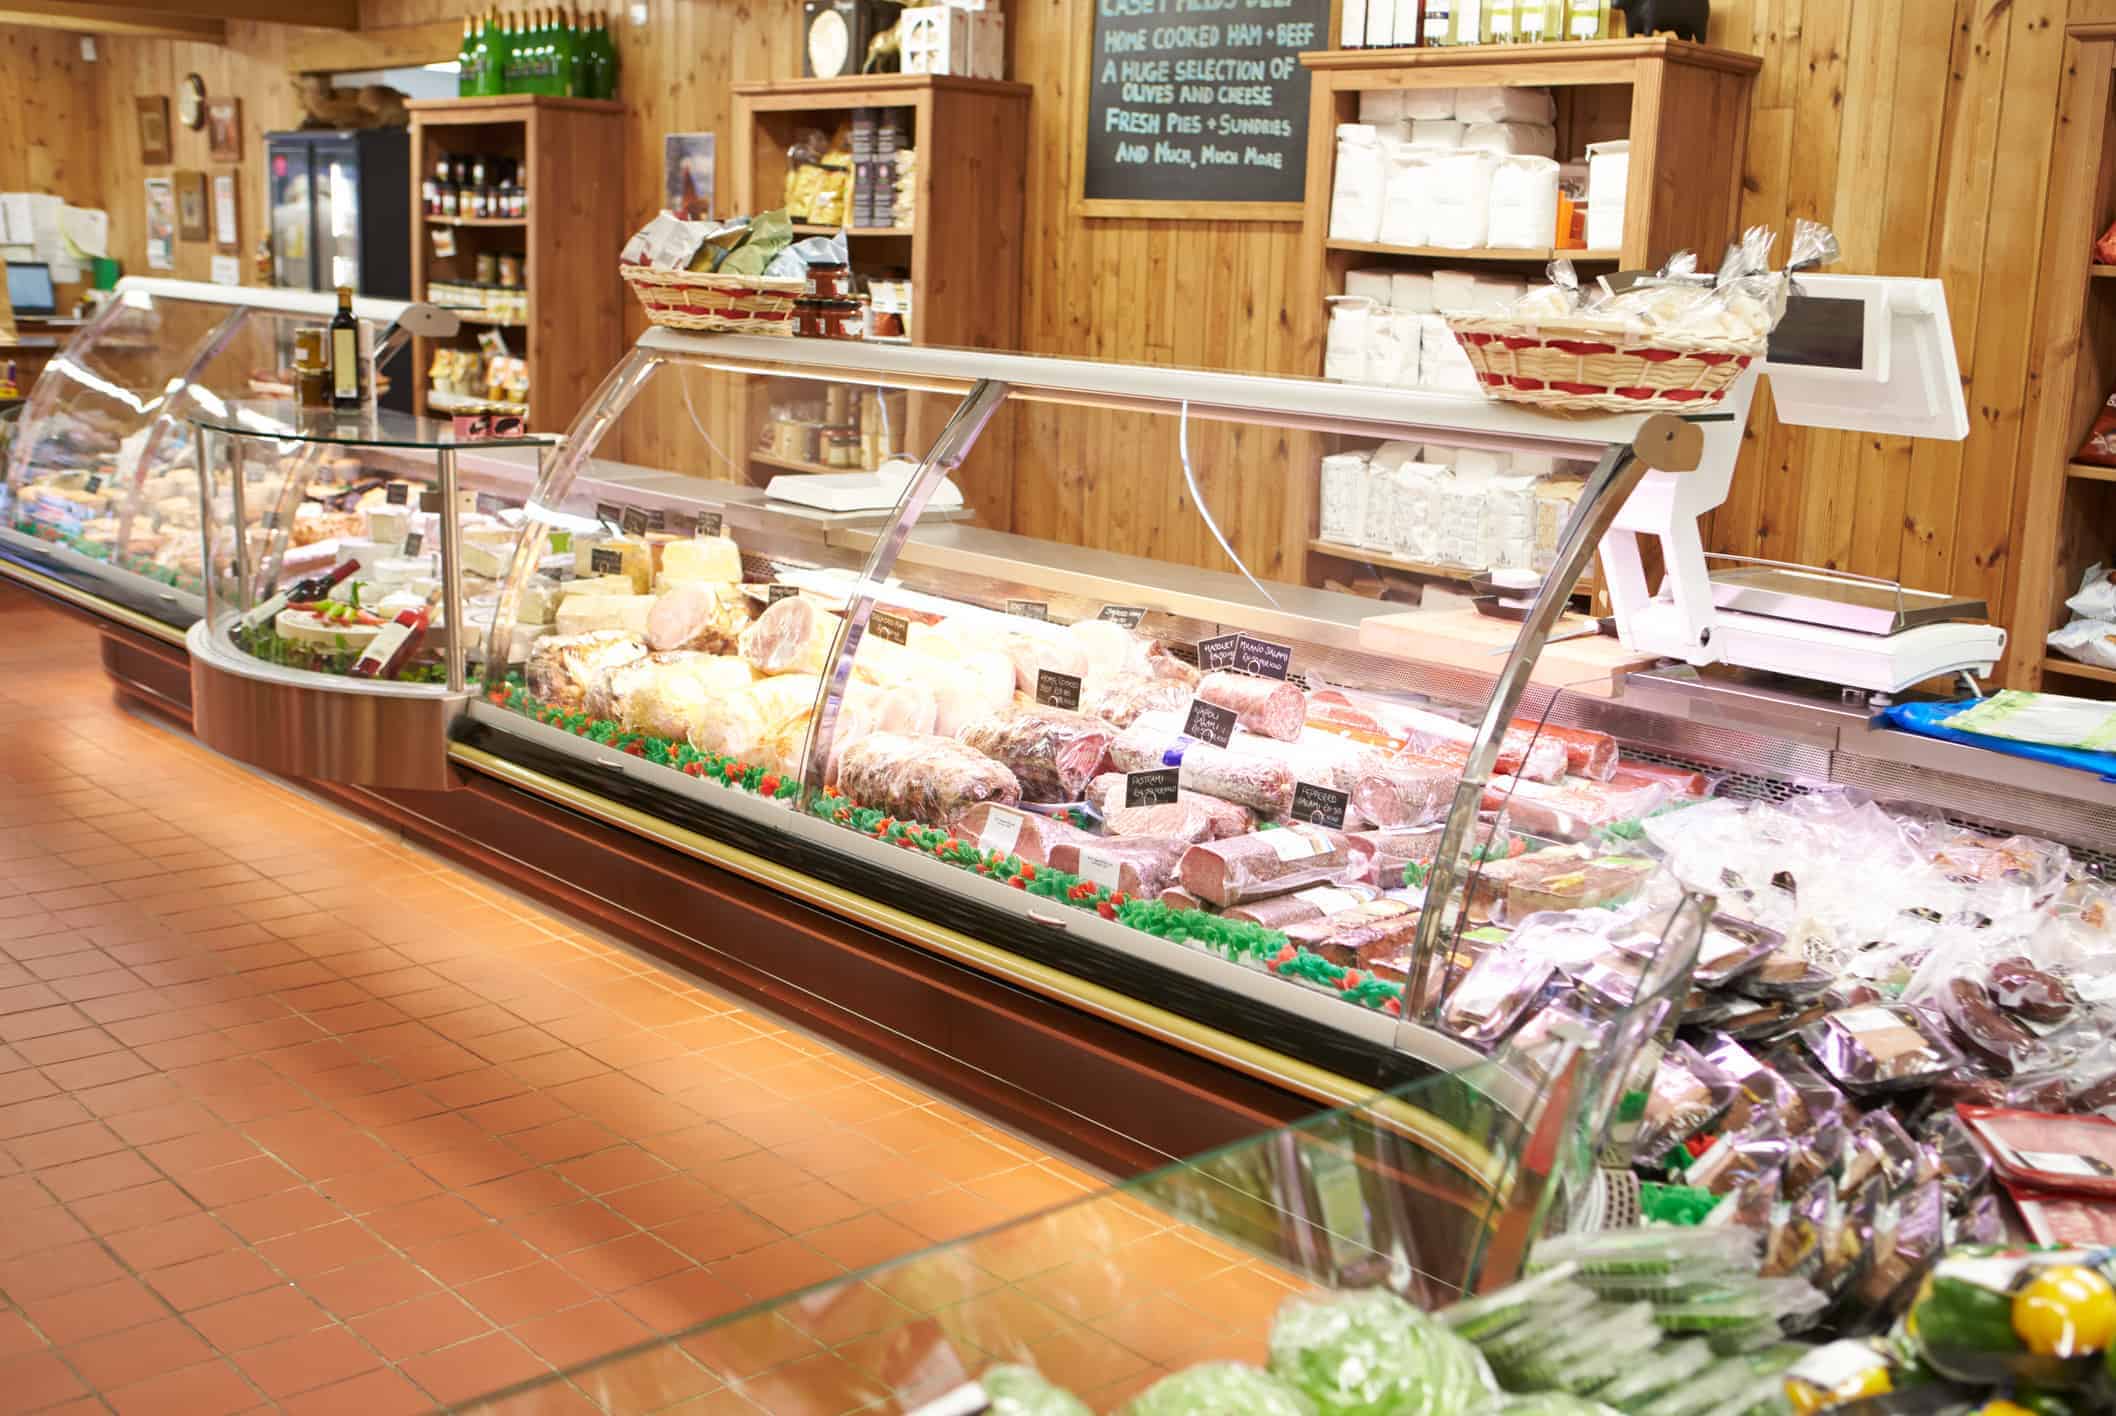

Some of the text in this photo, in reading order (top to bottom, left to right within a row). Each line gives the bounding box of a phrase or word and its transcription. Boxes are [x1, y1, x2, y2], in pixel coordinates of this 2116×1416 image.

[1104, 28, 1147, 52] HOME
[1152, 24, 1219, 49] COOKED
[1226, 23, 1262, 46] HAM
[1102, 56, 1296, 84] A HUGE SELECTION OF
[1121, 84, 1273, 107] OLIVES AND CHEESE
[1105, 107, 1160, 134] FRESH
[1167, 112, 1201, 134] PIES
[1115, 141, 1149, 164] AND
[1201, 145, 1238, 165] MUCH
[1244, 146, 1283, 170] MORE
